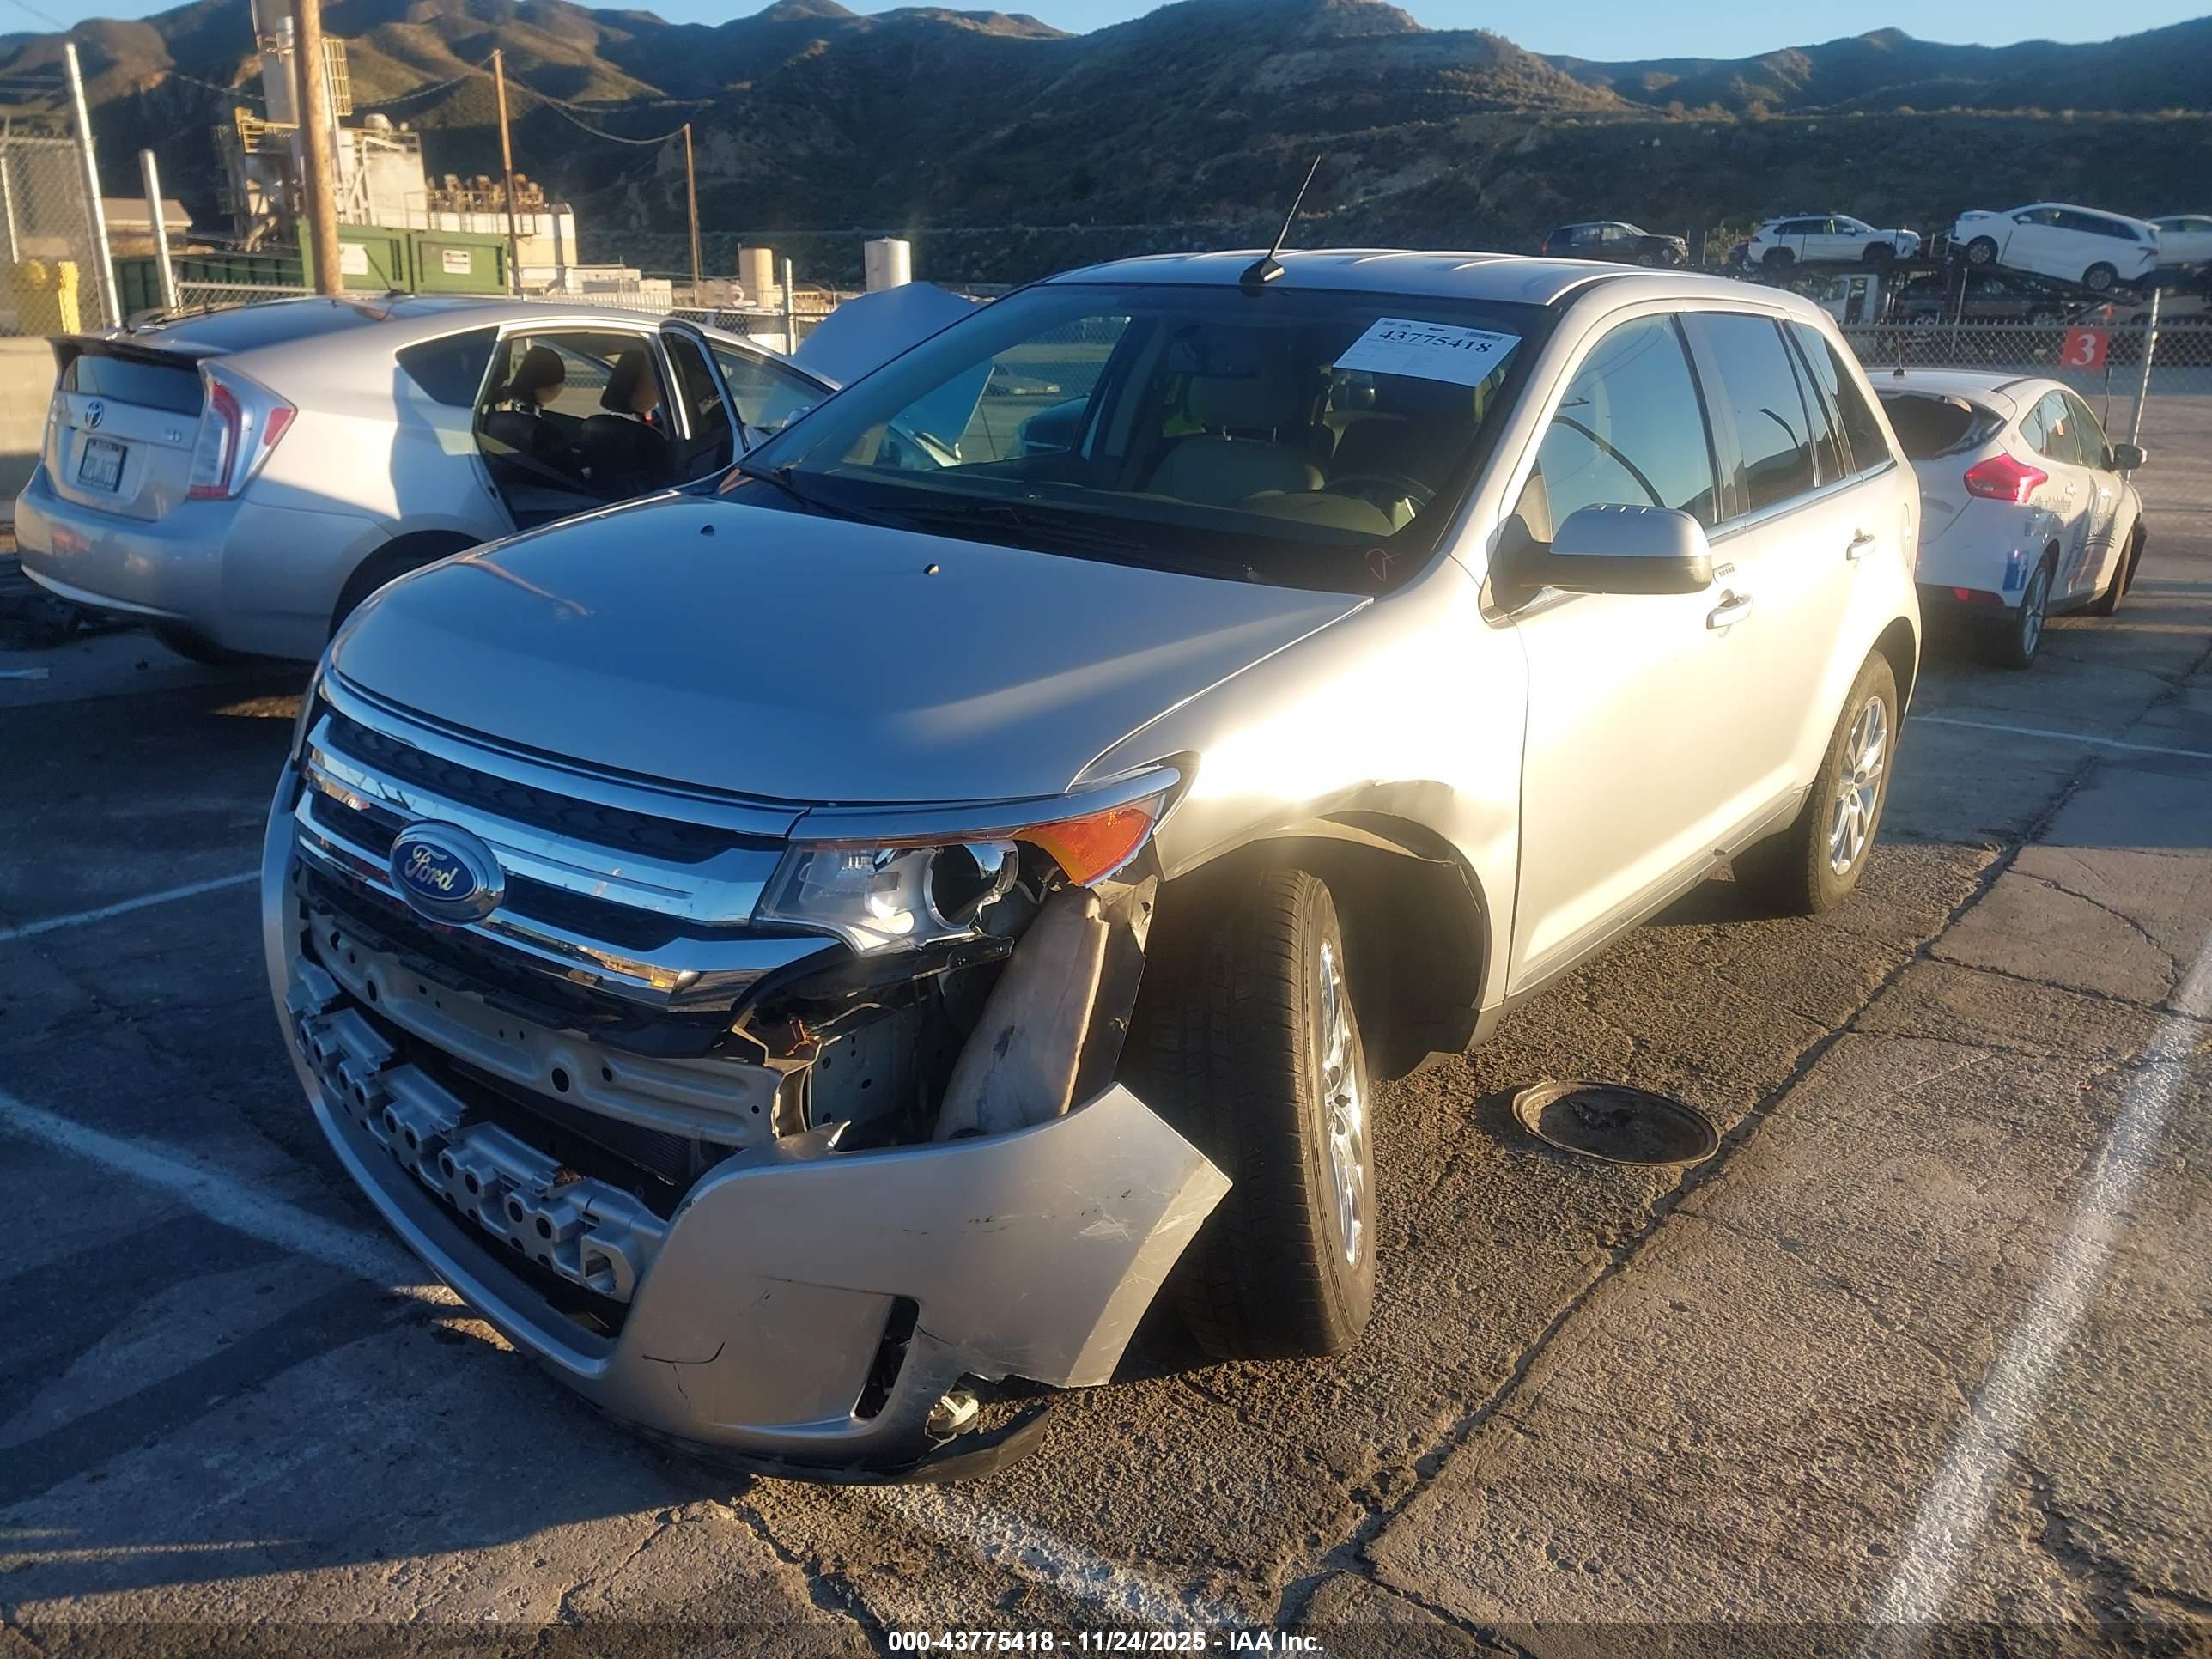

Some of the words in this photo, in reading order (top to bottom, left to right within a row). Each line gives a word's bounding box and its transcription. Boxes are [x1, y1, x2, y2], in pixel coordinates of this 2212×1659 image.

[1379, 330, 1493, 353] 43775418
[2070, 333, 2097, 366] 3
[404, 843, 459, 892] Ford
